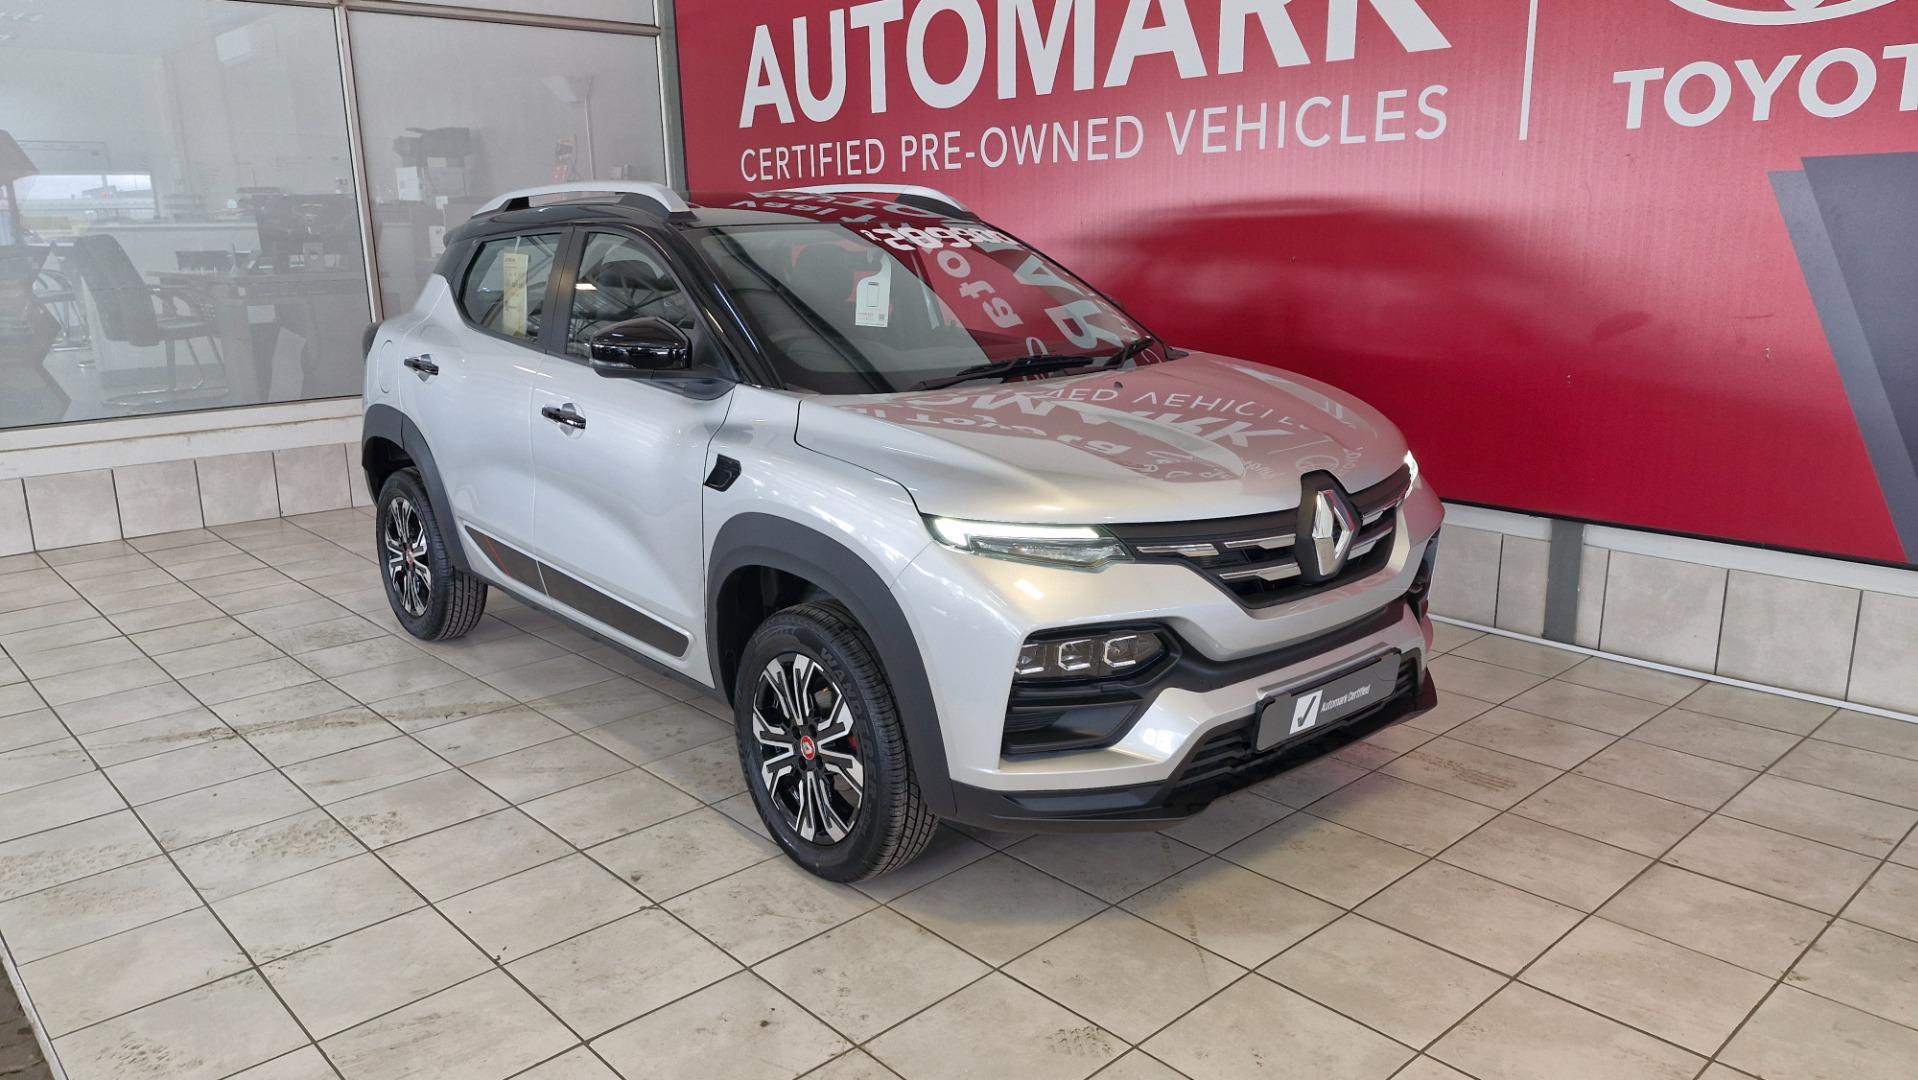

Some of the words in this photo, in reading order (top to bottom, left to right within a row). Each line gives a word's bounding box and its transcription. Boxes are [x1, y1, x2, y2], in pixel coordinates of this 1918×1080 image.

[1612, 43, 1918, 129] TOYOT
[740, 138, 885, 182] CERTIFIED
[901, 115, 1144, 173] PRE-OWNED
[1166, 85, 1450, 156] VEHICLES
[1321, 694, 1348, 712] Automark
[1348, 684, 1371, 702] Certified
